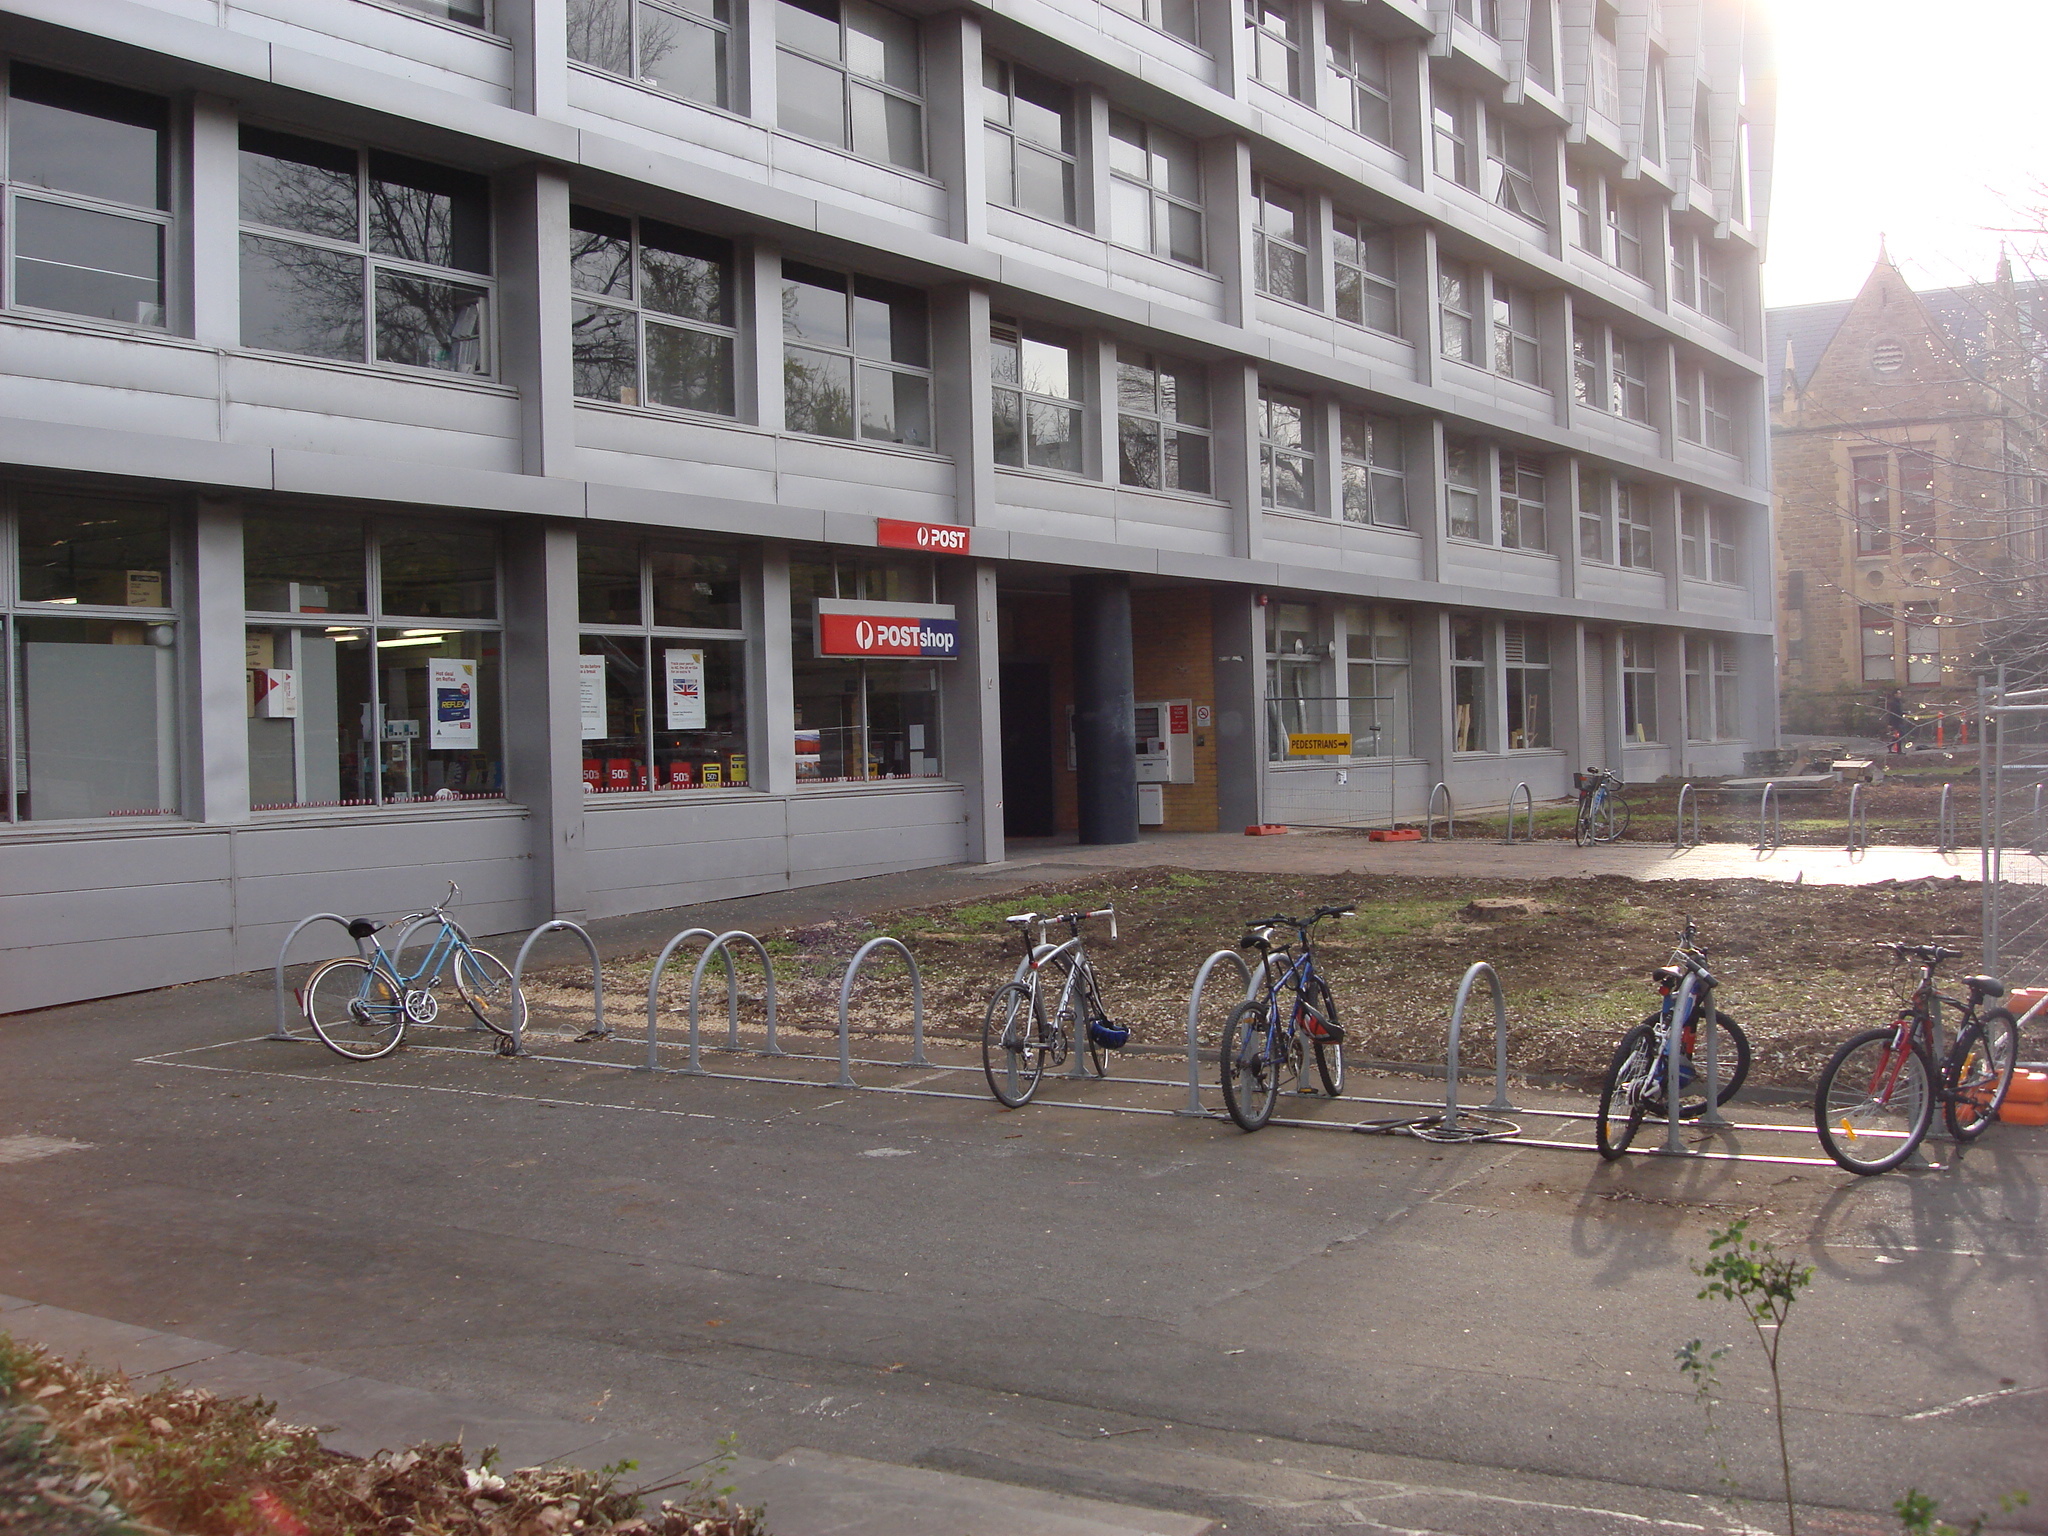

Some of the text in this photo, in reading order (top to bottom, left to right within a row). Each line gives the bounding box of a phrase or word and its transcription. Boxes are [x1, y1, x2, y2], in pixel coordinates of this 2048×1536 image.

[931, 529, 965, 549] POST
[877, 625, 954, 652] POSTshop
[442, 700, 465, 709] REFLEX
[1291, 739, 1338, 749] PEDESTRIANS
